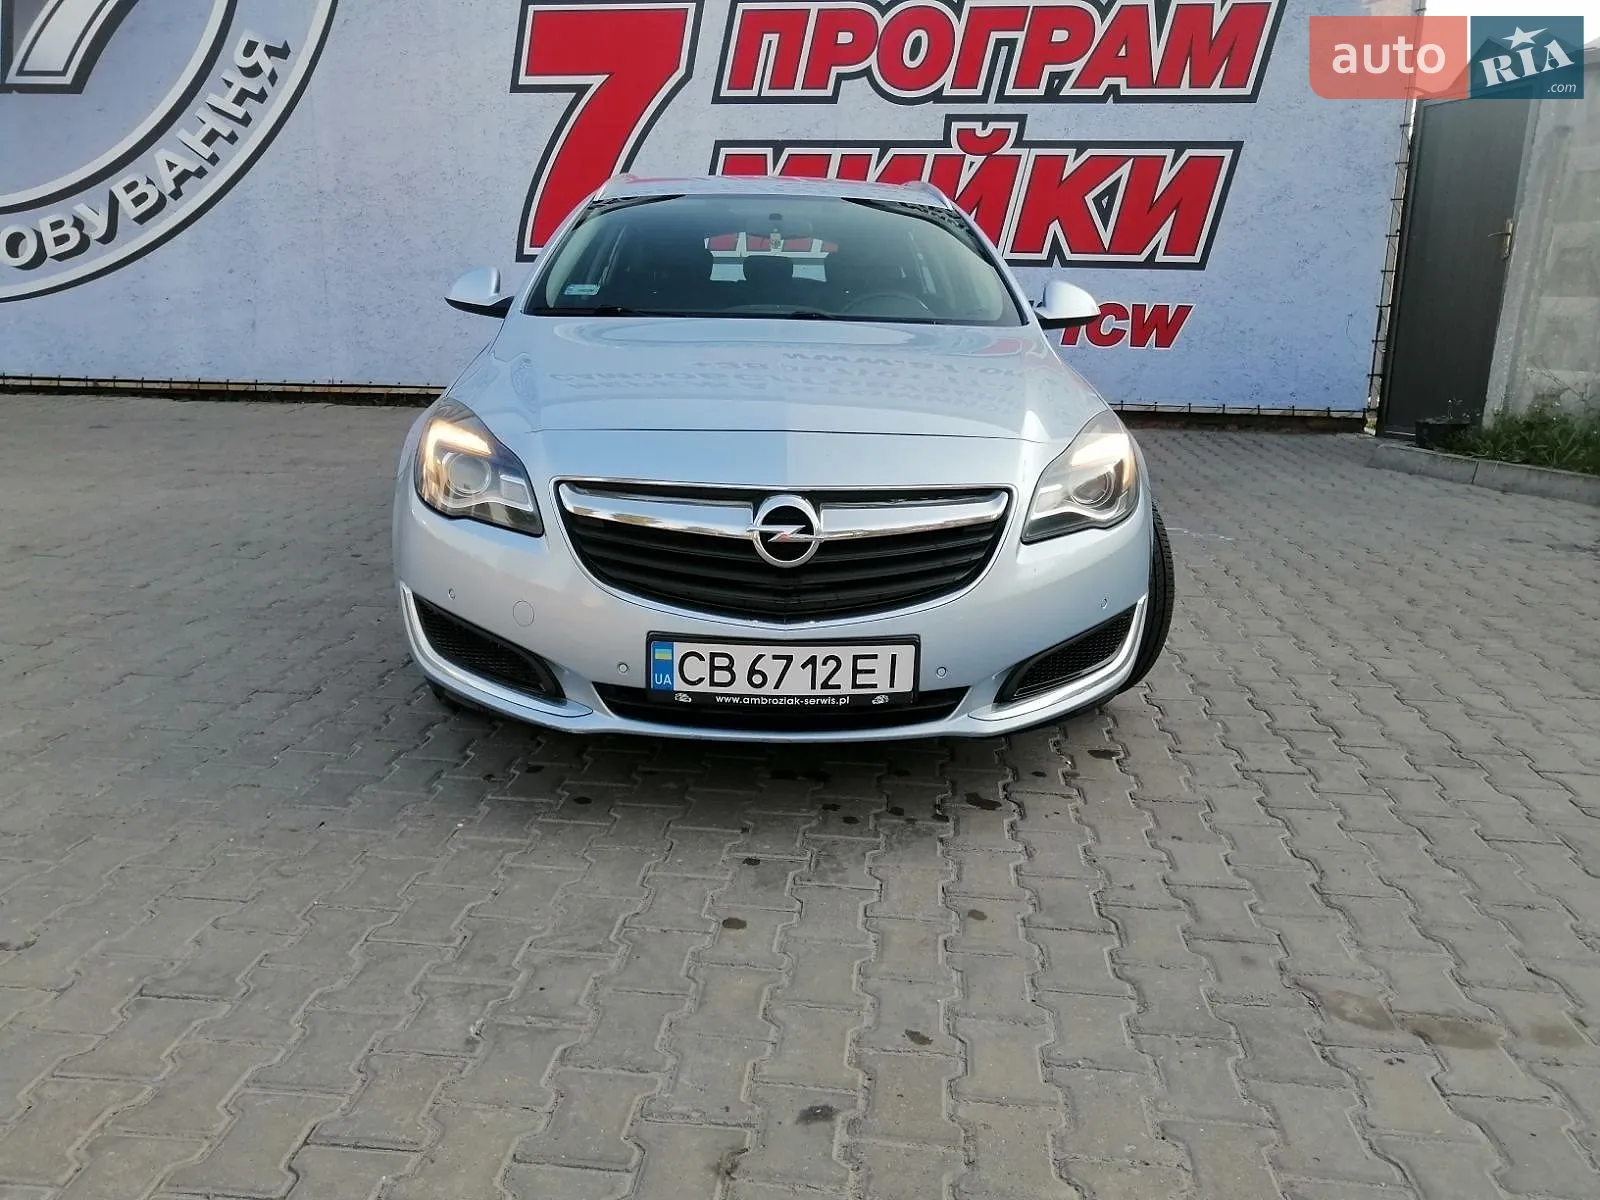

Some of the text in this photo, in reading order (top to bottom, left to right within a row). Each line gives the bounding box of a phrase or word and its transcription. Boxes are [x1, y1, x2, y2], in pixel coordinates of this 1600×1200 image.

[519, 0, 1279, 255] 7 ПРОГРАМ
[717, 121, 1233, 262] ЙКИ
[655, 673, 672, 685] UA
[715, 694, 850, 705] www.ambroziak-serwis.pl
